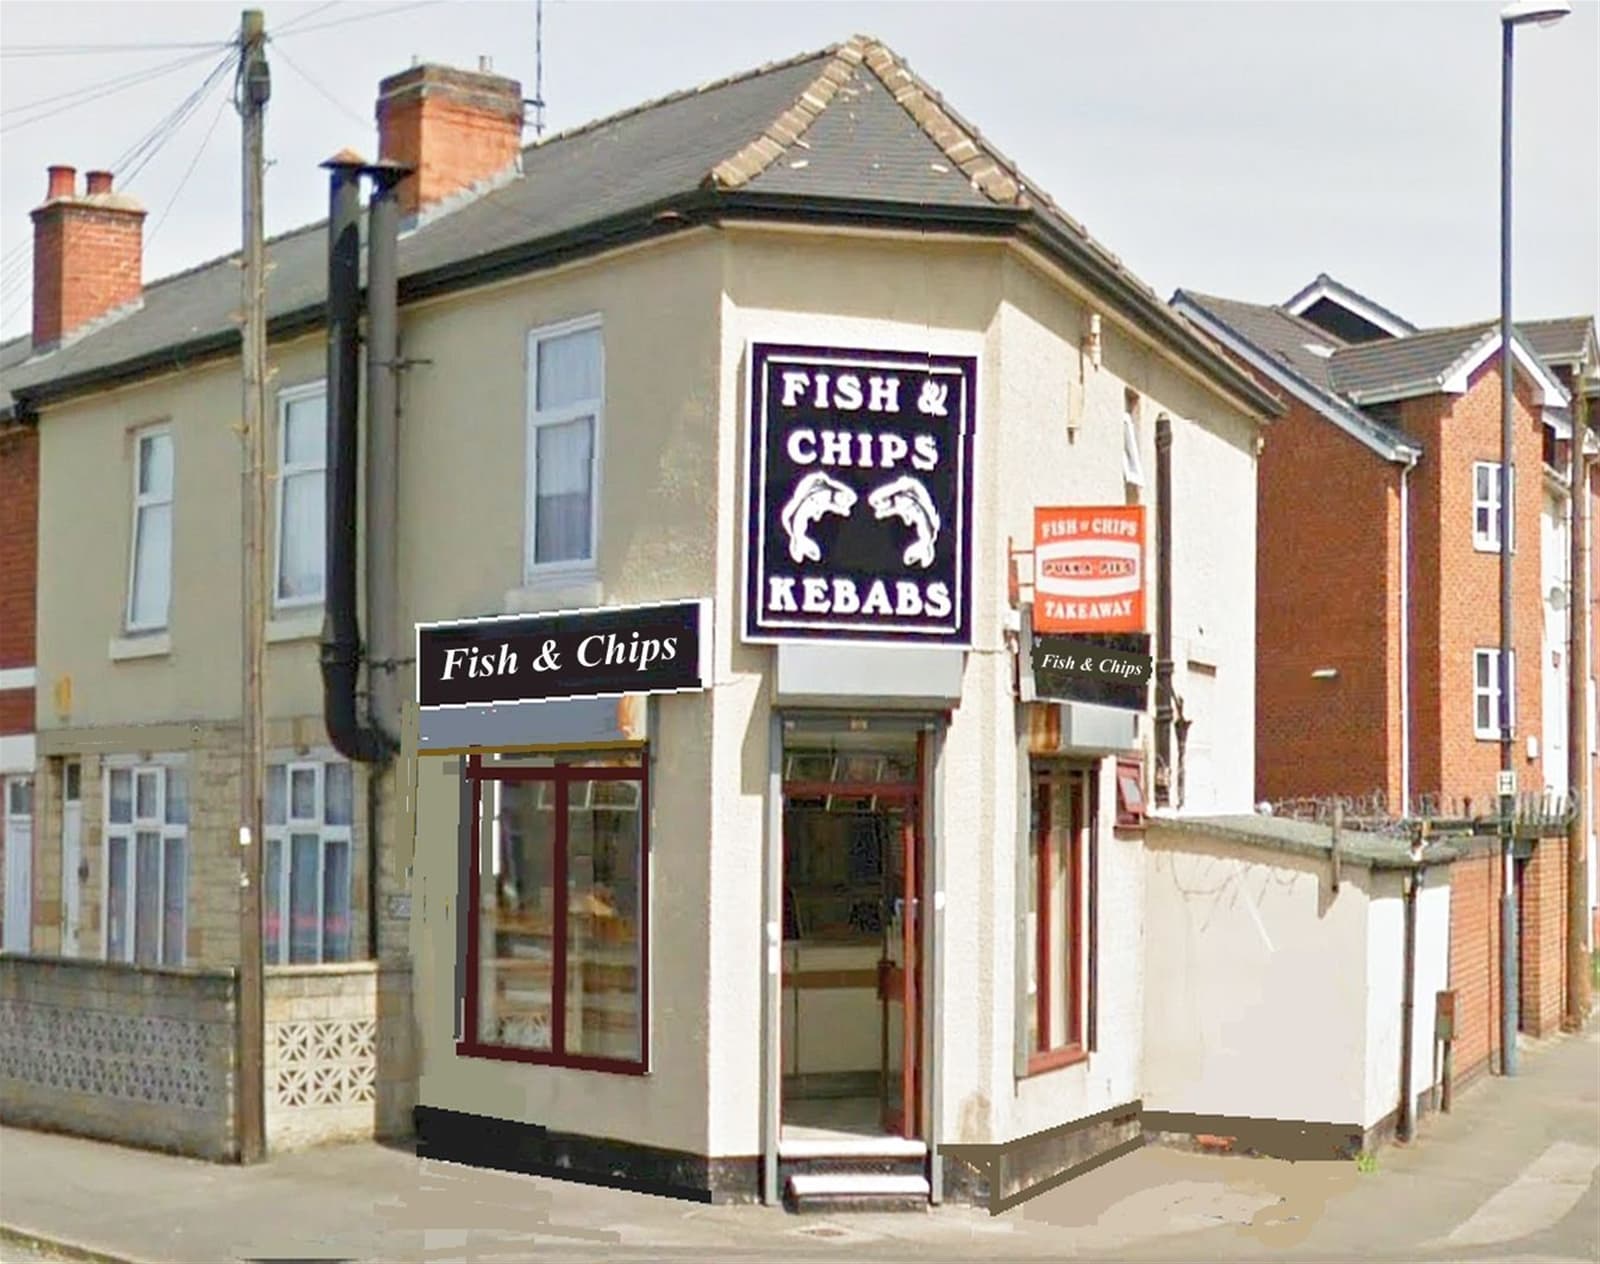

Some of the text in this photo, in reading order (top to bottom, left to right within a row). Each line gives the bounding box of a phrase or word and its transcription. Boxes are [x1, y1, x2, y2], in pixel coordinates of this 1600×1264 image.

[781, 372, 949, 416] FISH &
[787, 429, 938, 470] CHIPS
[1041, 519, 1078, 539] FISH
[1091, 518, 1138, 537] CHIPS
[768, 576, 952, 618] KEBABS
[1044, 600, 1134, 620] TAKEAWAY
[440, 631, 678, 681] Fish & Chips
[1041, 653, 1143, 677] Fish & Chips
